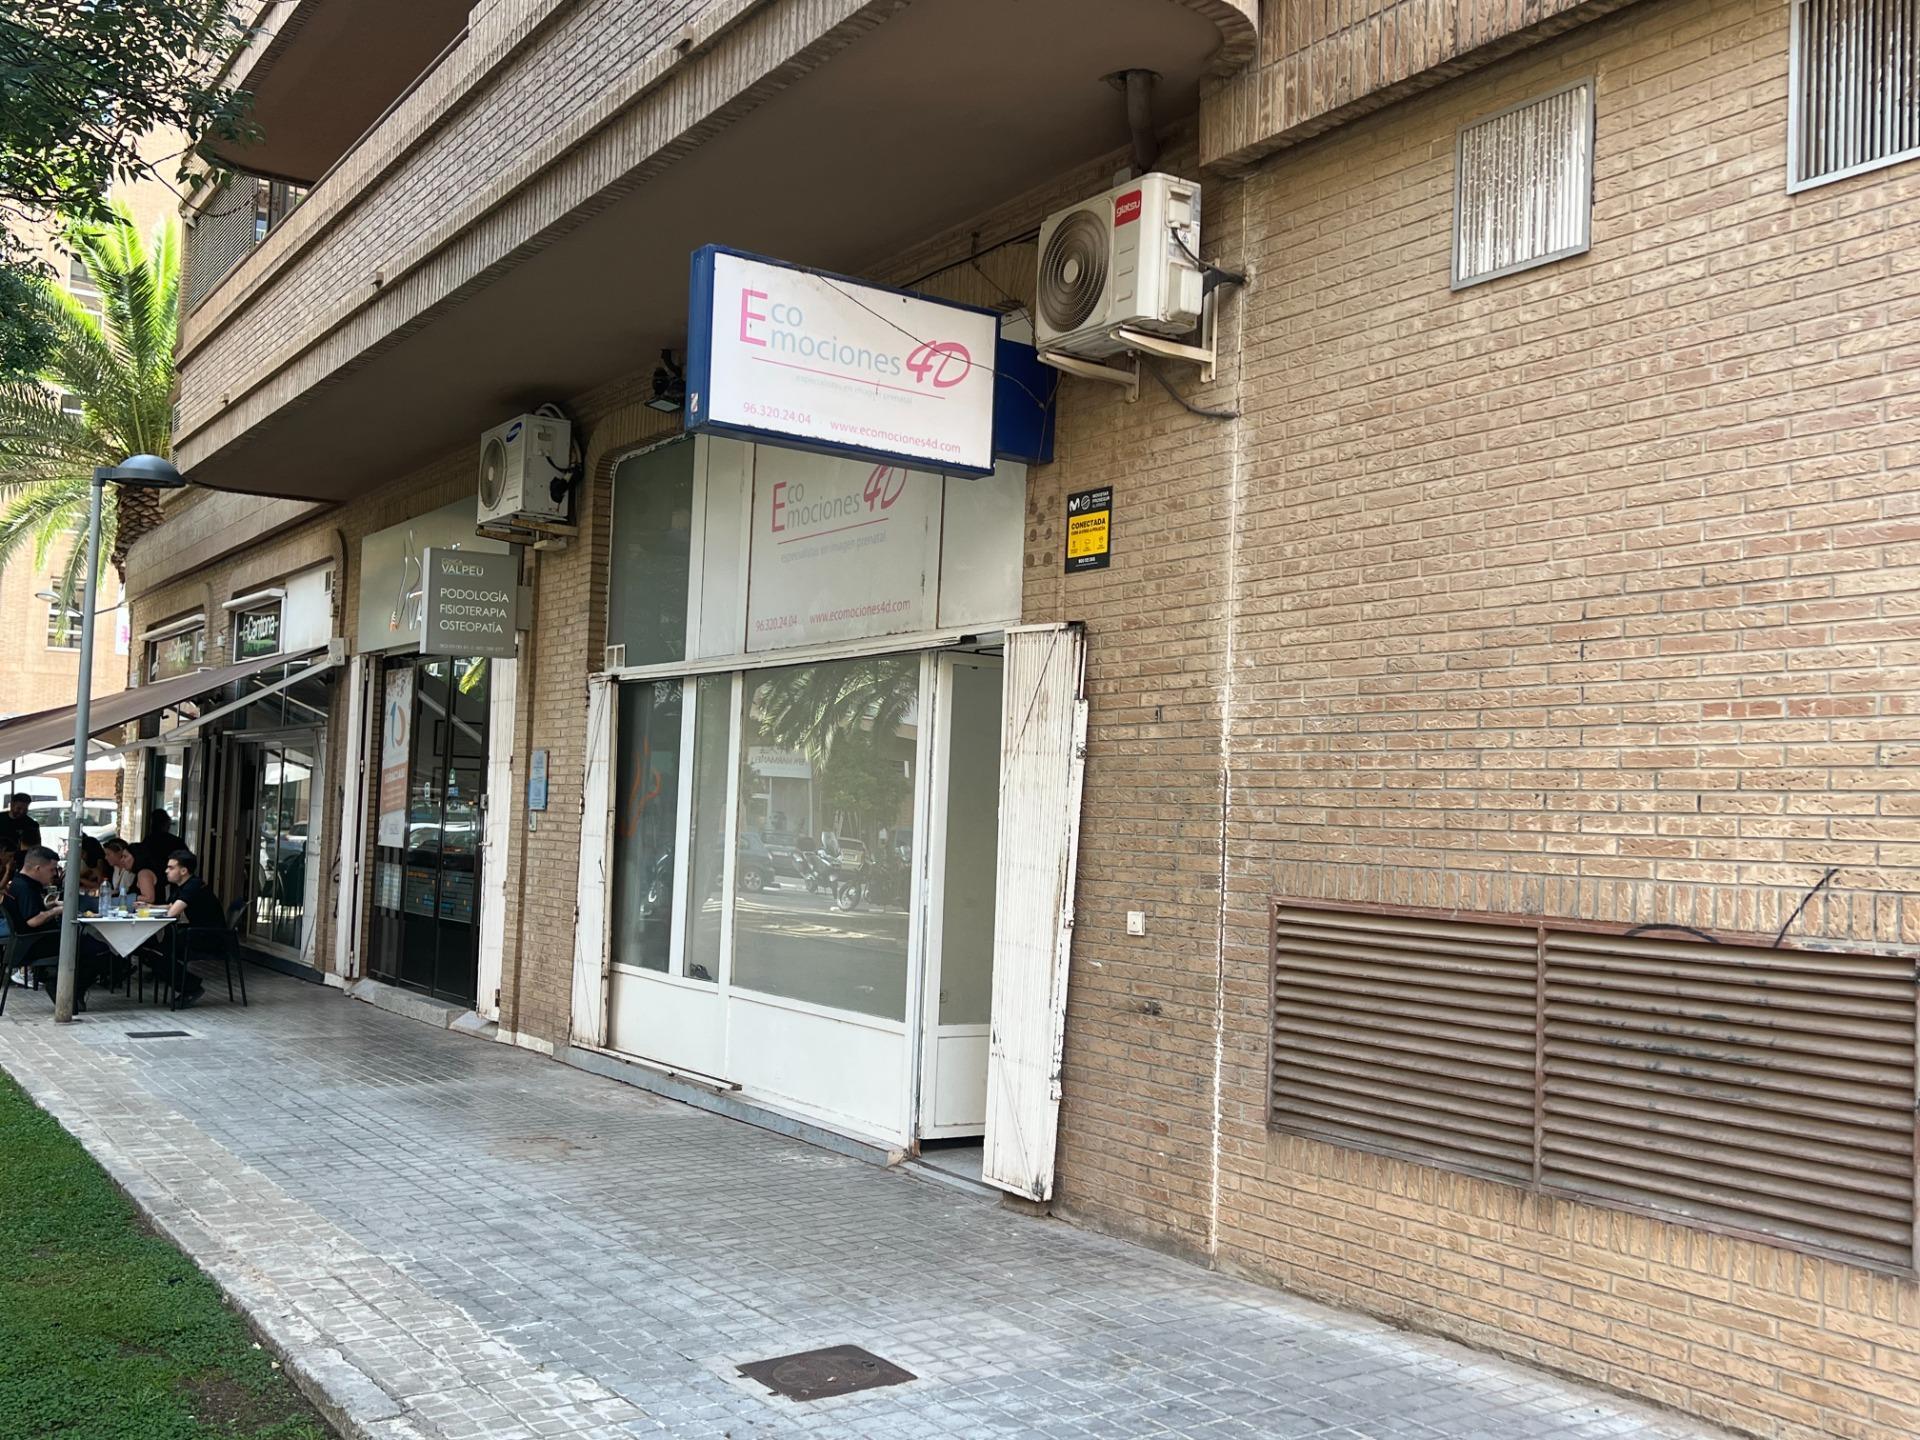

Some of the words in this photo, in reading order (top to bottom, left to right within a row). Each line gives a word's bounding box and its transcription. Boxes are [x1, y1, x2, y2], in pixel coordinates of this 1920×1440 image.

[743, 402, 811, 425] 96.320.24.04
[830, 420, 961, 454] www.ecomociones4d.com
[1070, 517, 1106, 530] CONECTADA
[441, 564, 484, 577] VALPEU
[440, 587, 509, 603] PODOLOGÍA
[439, 603, 507, 618] FISIOTERAPIA
[809, 600, 911, 625] www.ecomociones4d.com
[439, 619, 503, 634] OSTEOPATÍA
